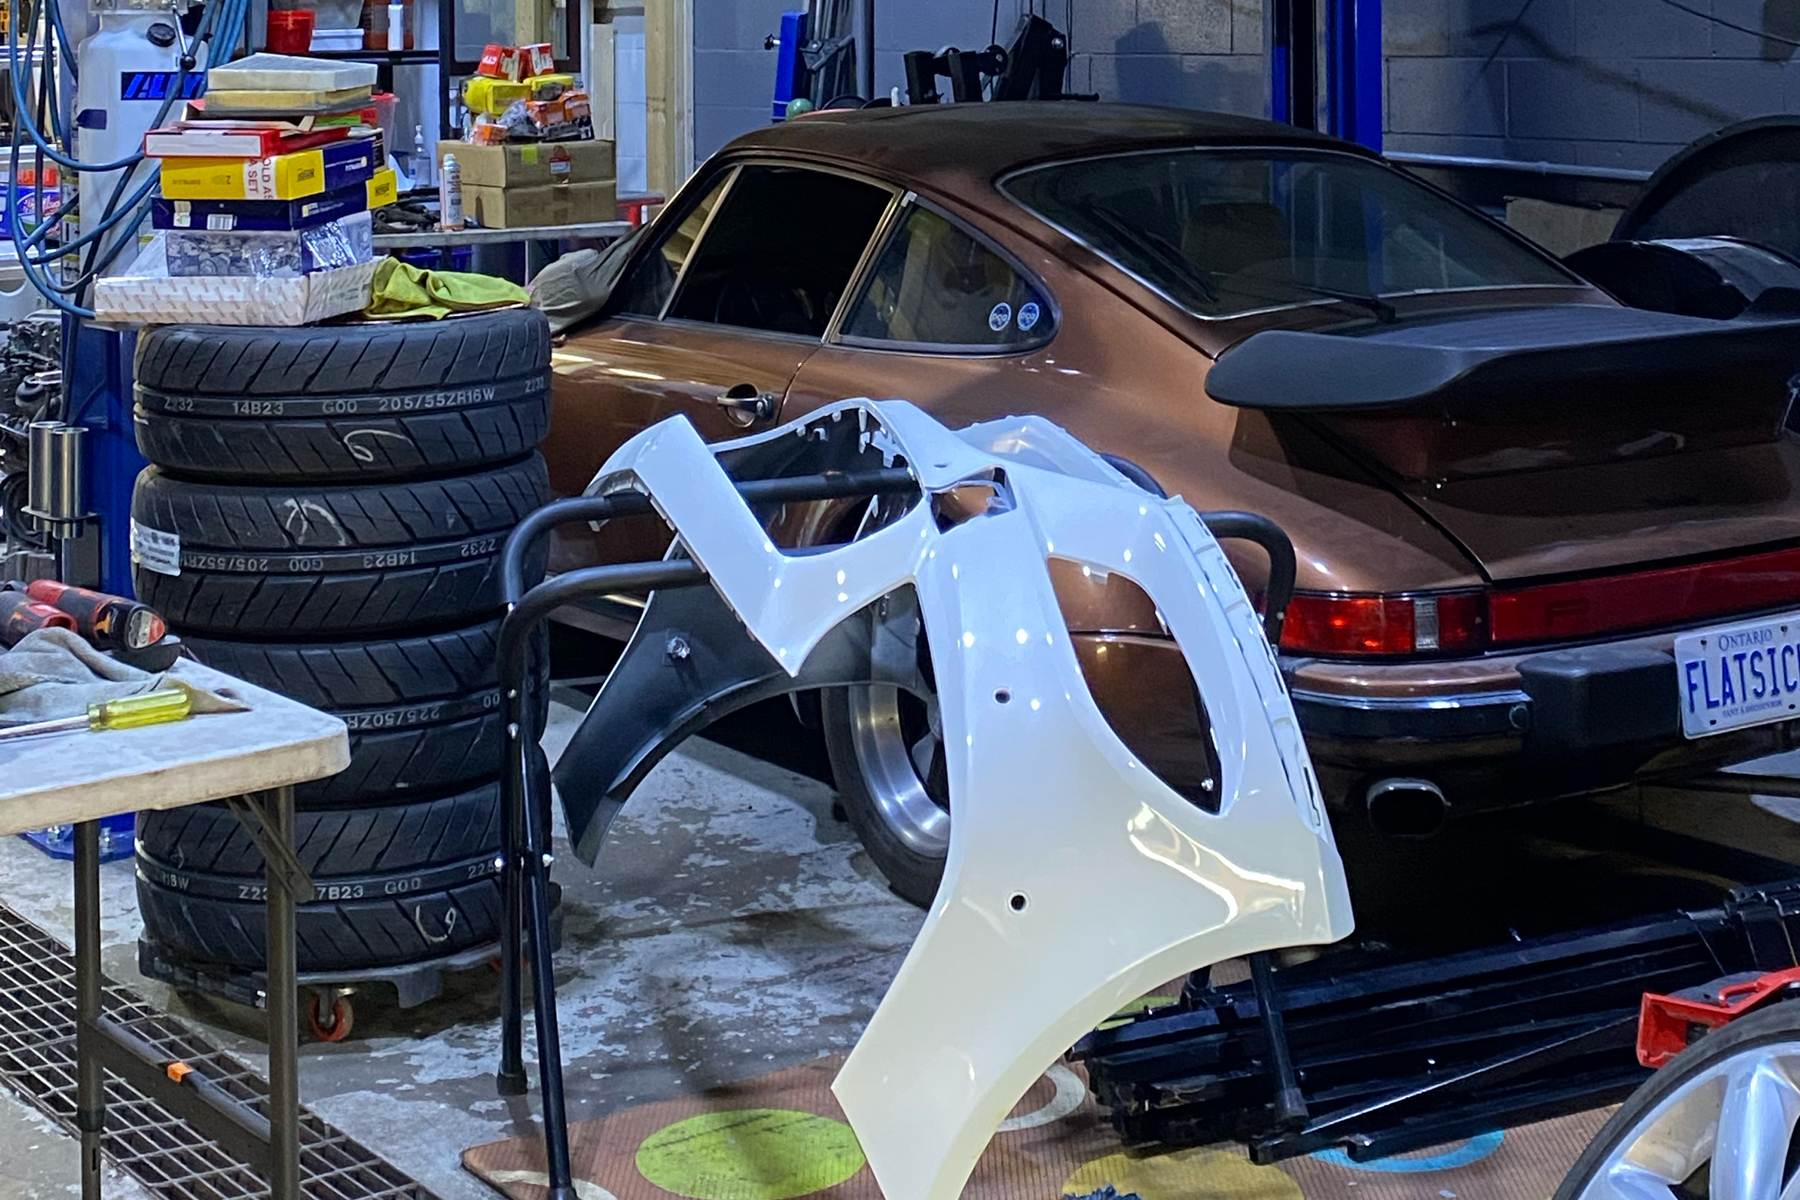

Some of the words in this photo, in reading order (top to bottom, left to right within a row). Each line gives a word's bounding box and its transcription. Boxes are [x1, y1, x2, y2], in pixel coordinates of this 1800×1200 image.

[248, 170, 259, 193] SET
[232, 401, 284, 415] 14B23
[379, 388, 495, 411] 205/55ZR16W
[181, 557, 269, 572] 205/55ZR1
[363, 551, 416, 568] 14B23
[1718, 629, 1773, 651] ONTARIO
